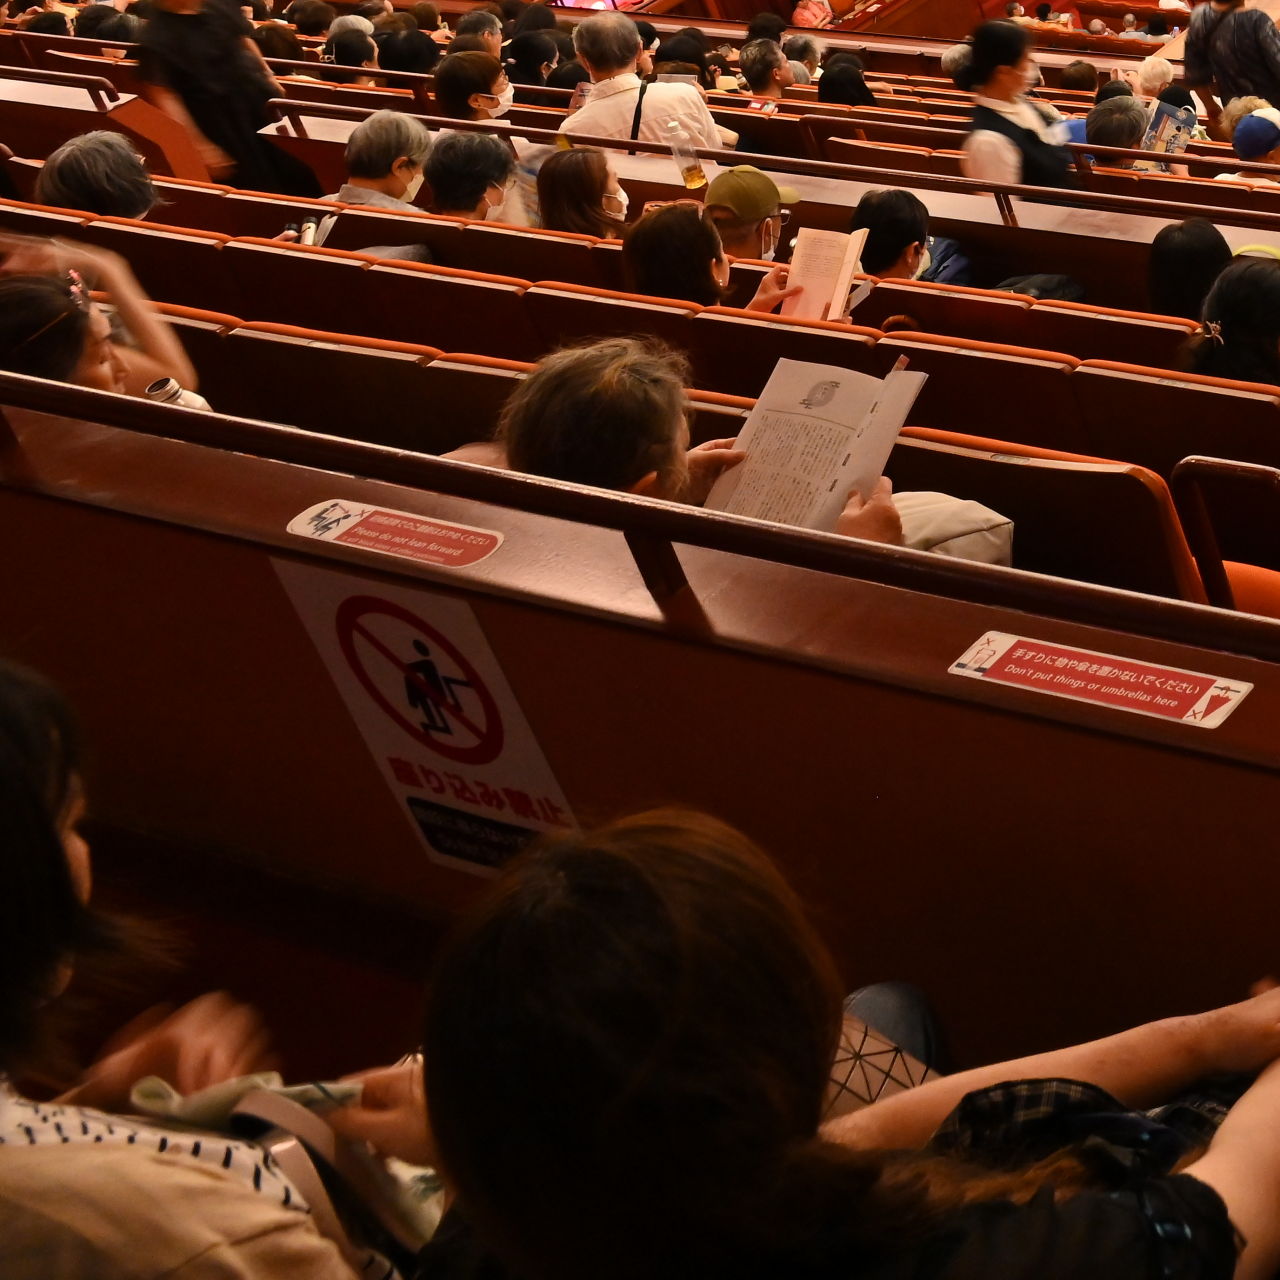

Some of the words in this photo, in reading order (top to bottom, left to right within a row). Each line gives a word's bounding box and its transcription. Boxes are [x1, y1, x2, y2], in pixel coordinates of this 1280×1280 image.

[351, 526, 379, 537] Please
[379, 532, 391, 540] do
[391, 535, 408, 544] not
[407, 538, 426, 548] lean
[1004, 663, 1033, 677] Don't
[1034, 671, 1053, 682] put
[1053, 674, 1085, 689] things
[1087, 681, 1100, 690] or
[1100, 684, 1151, 702] umbrellas
[1153, 695, 1178, 707] here
[1011, 647, 1200, 695] 手すりに物や傘を置かないでください
